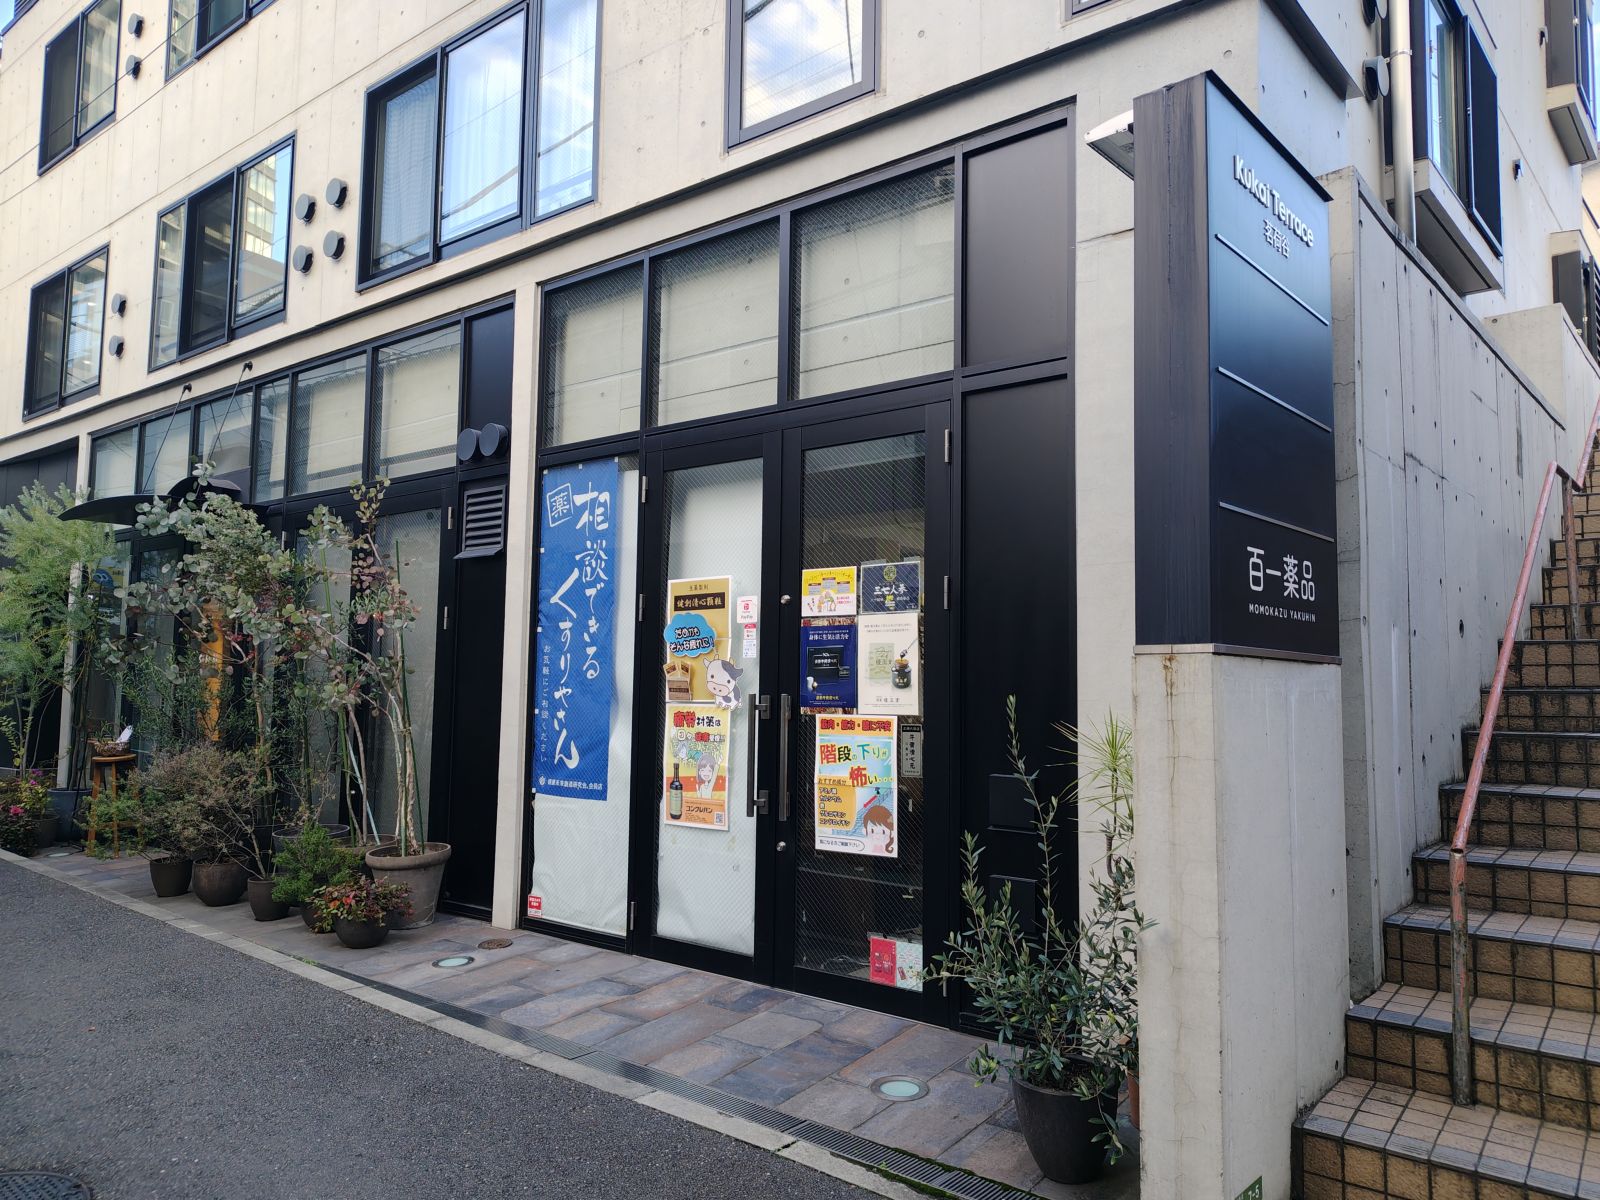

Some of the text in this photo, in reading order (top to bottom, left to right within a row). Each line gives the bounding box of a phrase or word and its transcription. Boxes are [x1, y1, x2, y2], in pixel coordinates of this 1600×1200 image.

[1234, 155, 1314, 247] Kukai Terrace
[551, 491, 570, 519] 薬
[573, 482, 610, 679] 相談できる
[873, 583, 908, 595] 三七人参
[1247, 546, 1315, 601] 百一薬品
[1249, 603, 1316, 623] MOMOKAZU YAKUHIN
[550, 568, 580, 769] くすりやさん
